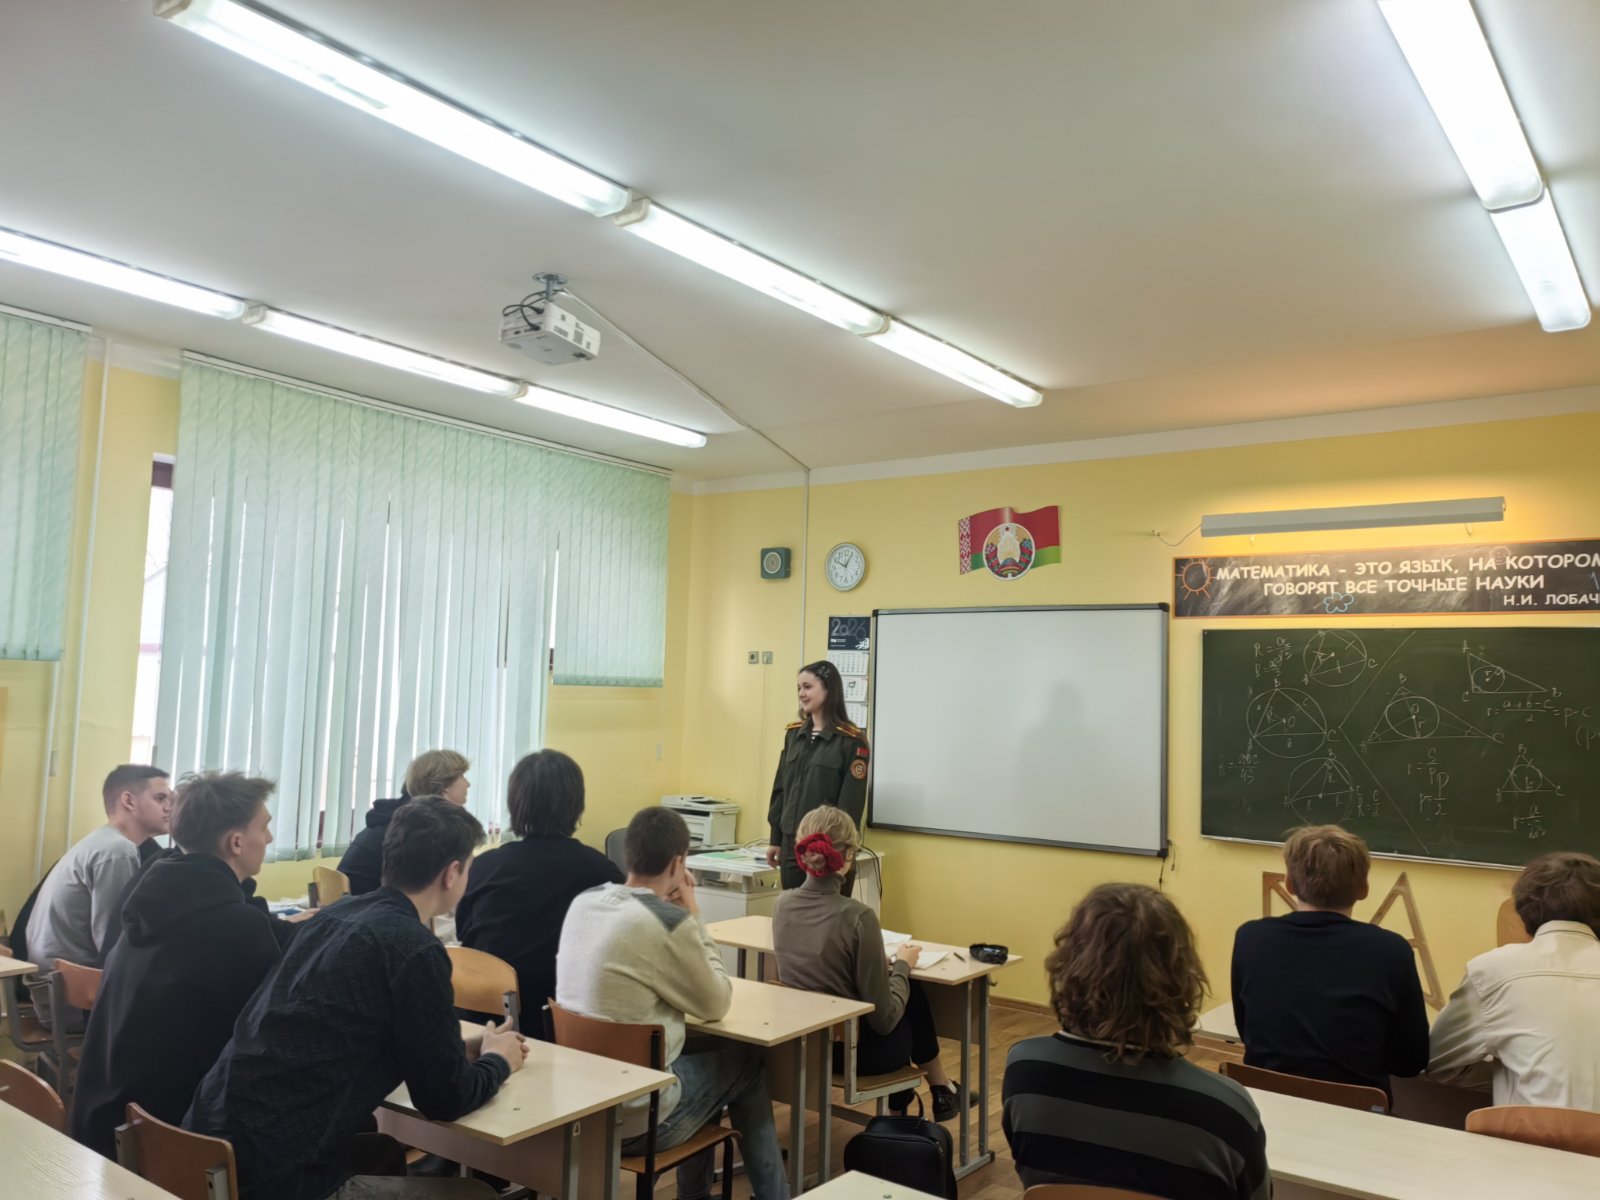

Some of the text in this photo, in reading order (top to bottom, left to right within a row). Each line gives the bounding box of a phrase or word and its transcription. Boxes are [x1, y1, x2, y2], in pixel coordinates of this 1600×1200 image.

[1216, 564, 1330, 580] МАТЕМАТИКА
[1355, 562, 1392, 576] ЭТО
[1399, 559, 1459, 574] ЯЗЫК,
[1469, 557, 1497, 571] НА
[1264, 575, 1545, 596] ГОВОРЯТ ВСЕ ТОЧНЫЕ НАУКИ
[1504, 593, 1600, 606] Н.И. ЛОБАЧ
[831, 618, 866, 640] 2026
